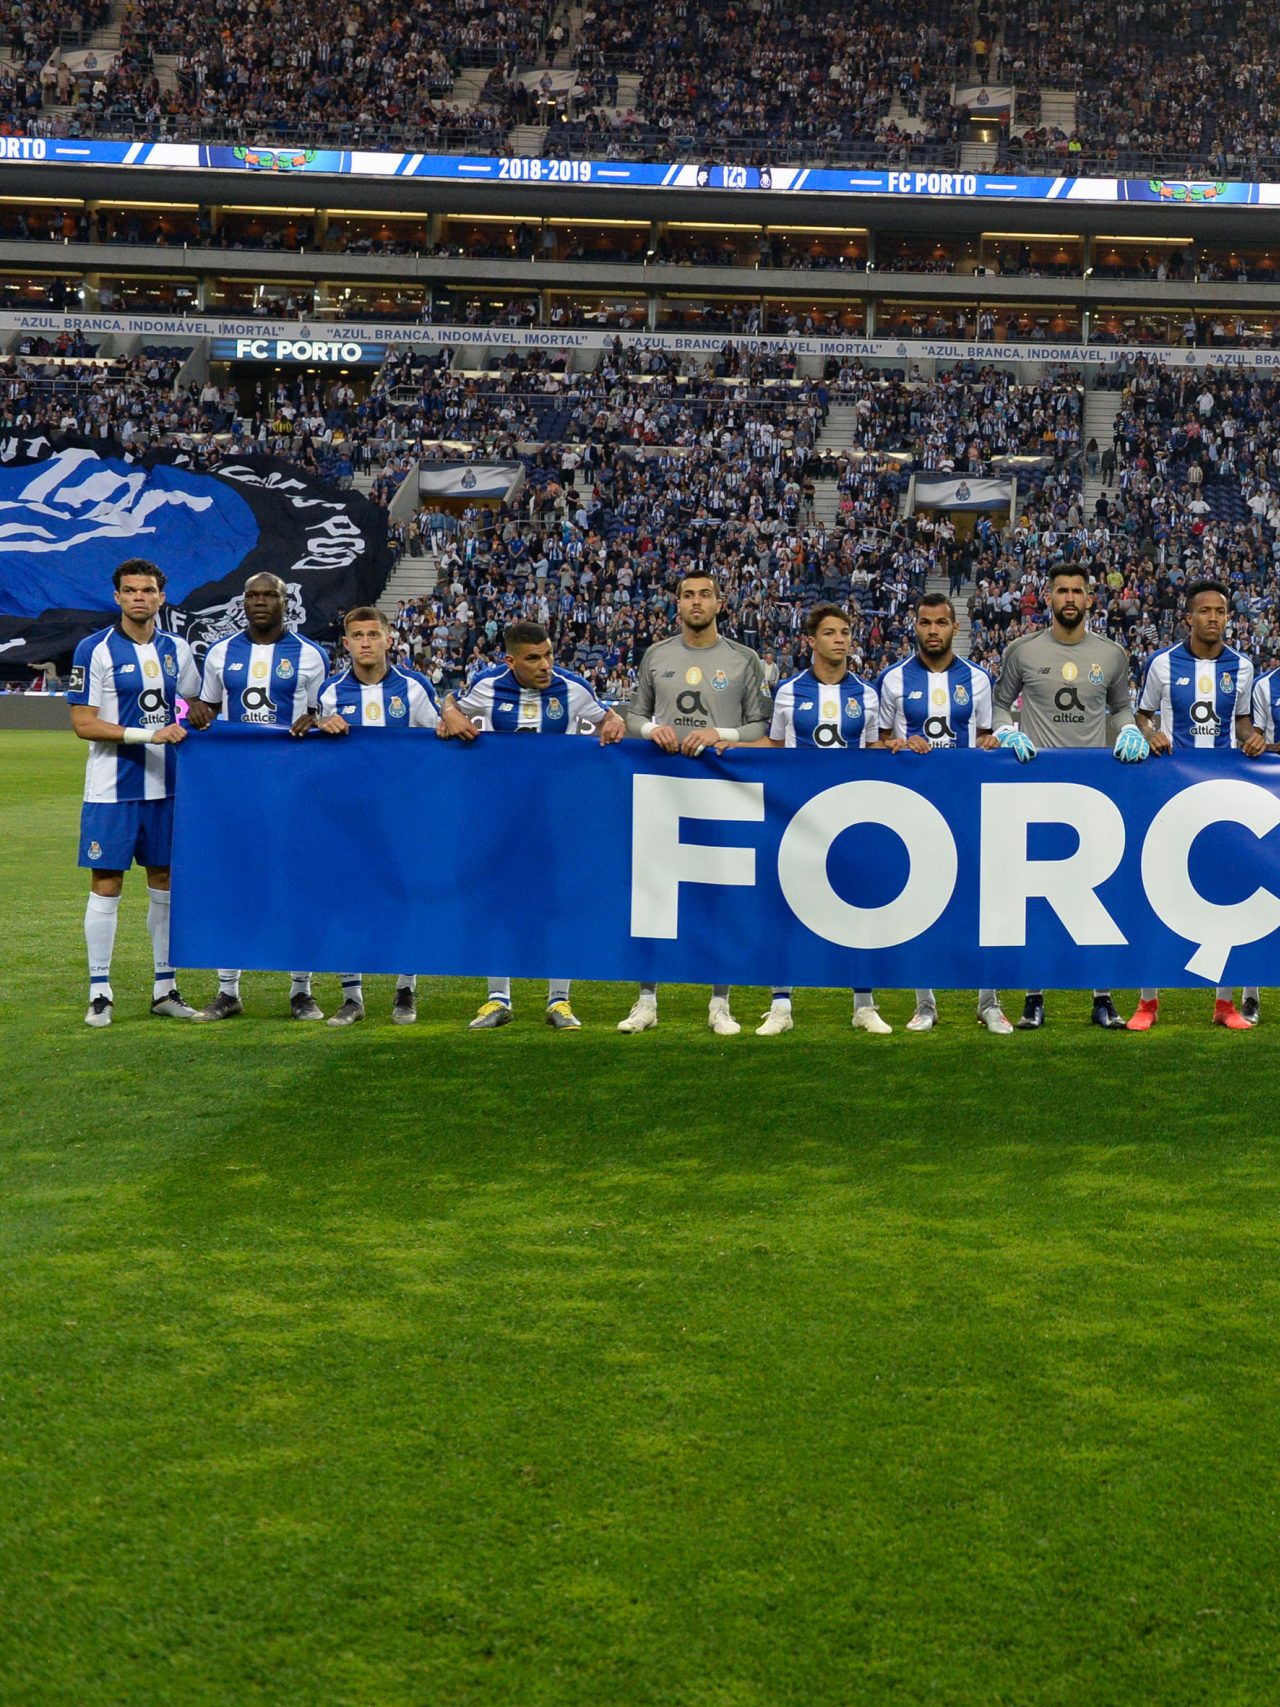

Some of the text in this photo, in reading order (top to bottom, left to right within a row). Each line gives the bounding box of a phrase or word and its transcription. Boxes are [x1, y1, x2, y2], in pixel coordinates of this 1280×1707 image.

[499, 158, 591, 182] 2018-2019
[888, 172, 976, 195] FC PORTO
[237, 340, 362, 362] FC PORTO
[139, 713, 170, 724] altice
[242, 711, 276, 724] altice
[674, 716, 707, 728] altice
[1053, 712, 1085, 723] altice
[1190, 725, 1220, 737] altice
